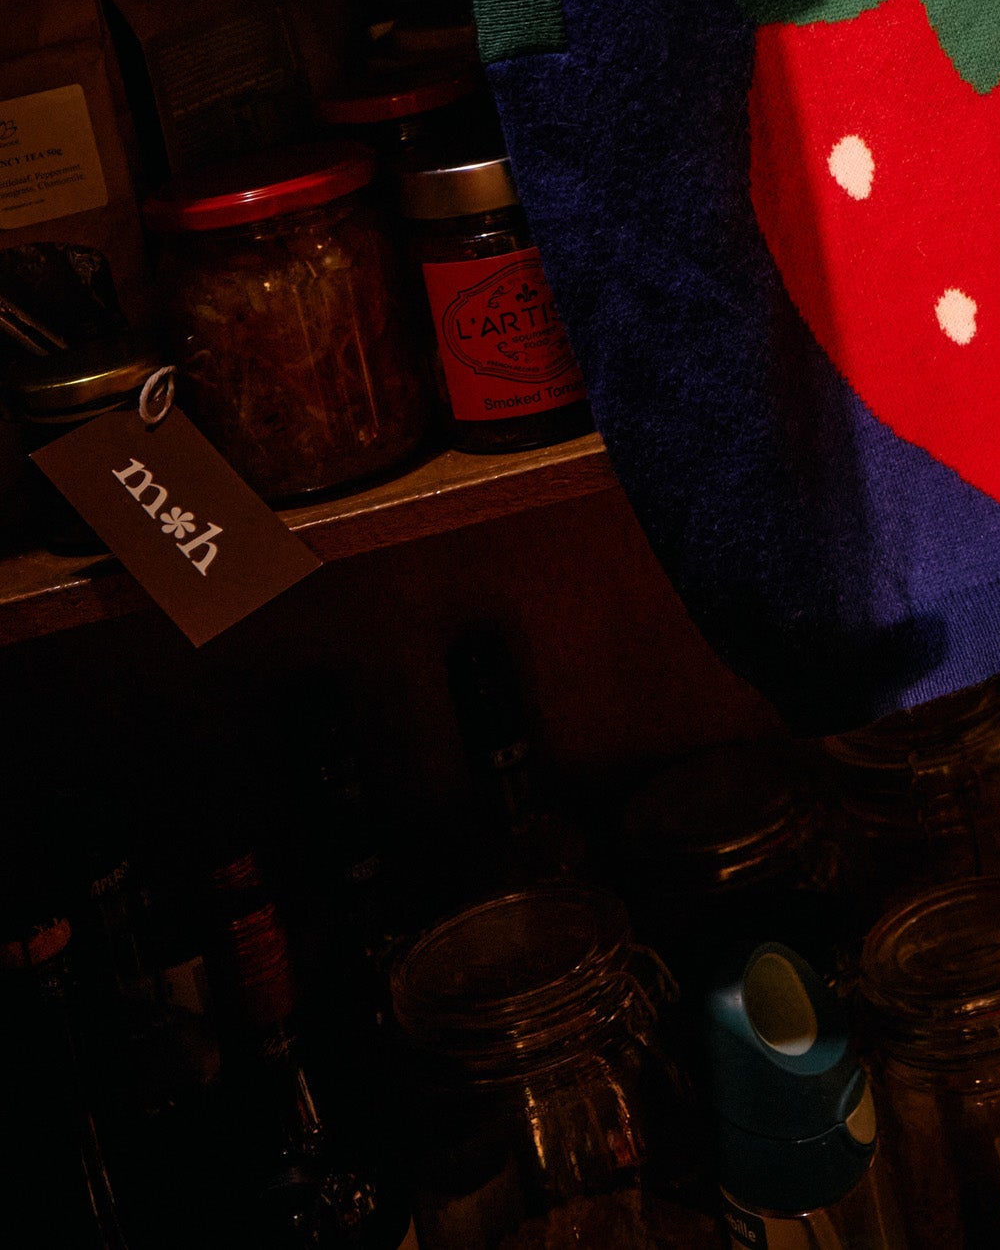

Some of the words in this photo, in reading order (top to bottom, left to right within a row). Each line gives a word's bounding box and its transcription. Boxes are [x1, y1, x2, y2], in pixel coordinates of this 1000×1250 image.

[23, 151, 44, 162] TEA
[512, 325, 558, 343] GOURMET
[523, 338, 549, 350] FOOD
[484, 391, 541, 411] Smoked
